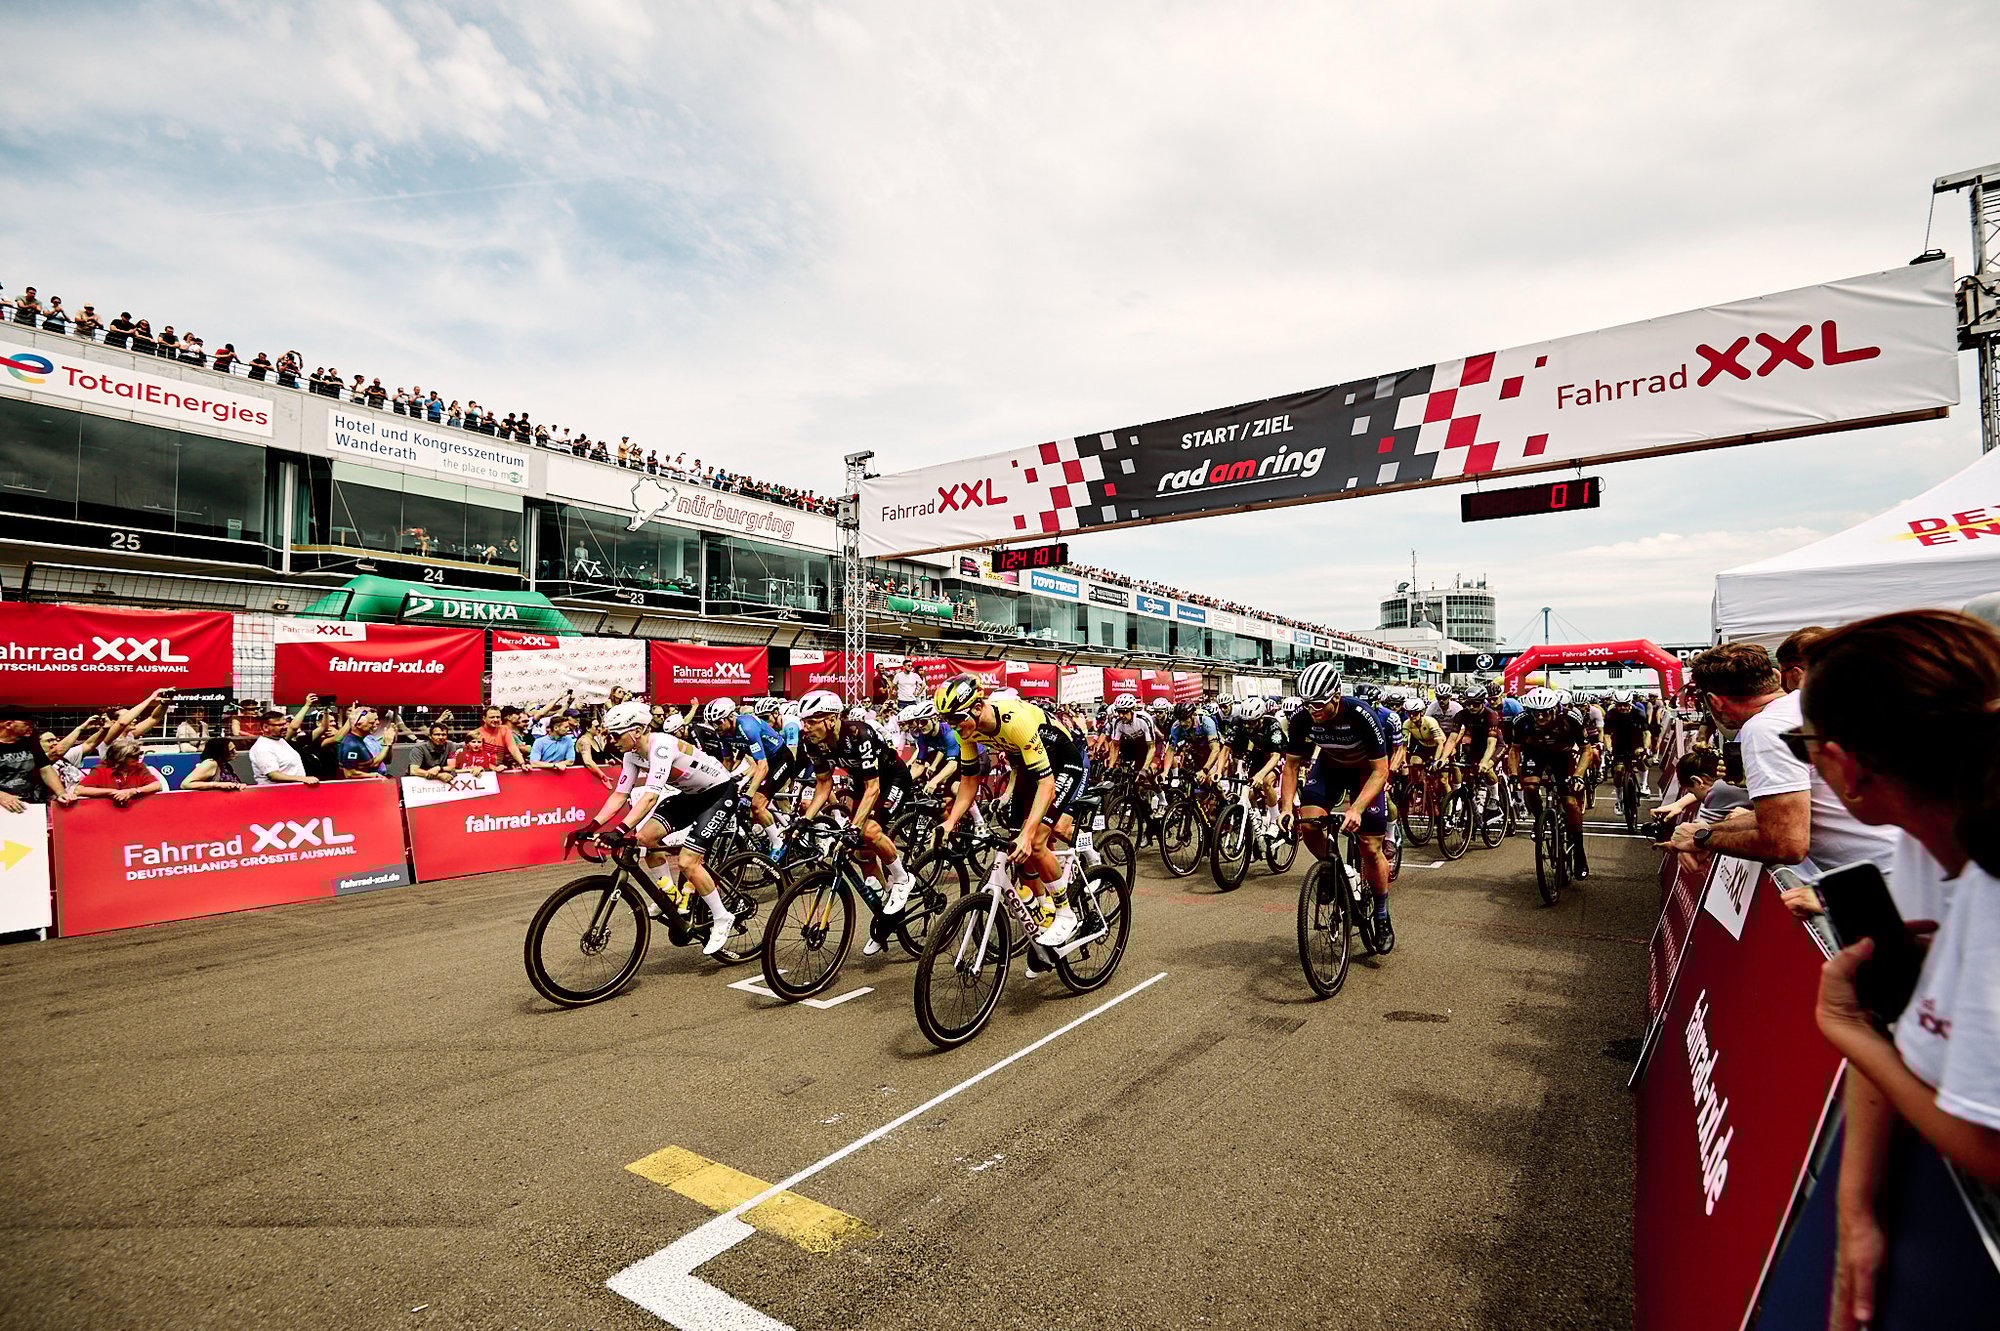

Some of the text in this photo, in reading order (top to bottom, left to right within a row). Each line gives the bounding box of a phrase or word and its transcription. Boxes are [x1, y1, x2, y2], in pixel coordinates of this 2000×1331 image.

[1557, 319, 1881, 410] Fahrrad XXL
[62, 365, 268, 425] TotalEnergies
[335, 415, 525, 468] Hotel und Kongresszentrum
[1181, 424, 1240, 450] START
[1252, 414, 1294, 438] ZIEL
[335, 432, 417, 461] Wanderath
[443, 457, 459, 470] the
[461, 461, 486, 477] place
[489, 468, 498, 478] to
[881, 477, 1008, 523] Fahrrad XXL
[676, 495, 795, 539] nürburgring
[110, 531, 142, 552] 25
[423, 568, 445, 583] 24
[1033, 575, 1078, 594] TOYO TIRES
[630, 592, 645, 605] 23
[443, 599, 519, 620] DEKRA
[777, 610, 789, 620] 22
[282, 626, 315, 635] Fahrrad
[316, 624, 353, 637] XXL
[498, 635, 551, 647] Fahrrad XXL
[0, 636, 190, 663] ahrrad XXL
[1562, 650, 1587, 658] Fahrrad
[1588, 647, 1614, 657] XXL
[81, 662, 134, 672] GRÖSSTE
[135, 664, 189, 673] AUSWAHL
[329, 656, 445, 674] fahrrad-xxl.de
[673, 661, 751, 678] Fahrrad XXL
[172, 693, 226, 702] ahrrad-xxl.de
[1360, 709, 1385, 746] KERN-HAUS
[412, 779, 486, 794] Fahrrad XXL
[465, 806, 586, 833] fahrrad-xxl.de
[124, 817, 356, 867] Fahrrad XXL
[126, 846, 357, 881] DEUTSCHLANDS GRÖSSTE AUSWAHL
[340, 873, 400, 889] fahrrad-xxl.de
[1685, 989, 1734, 1216] fahrrad-xxl.de
